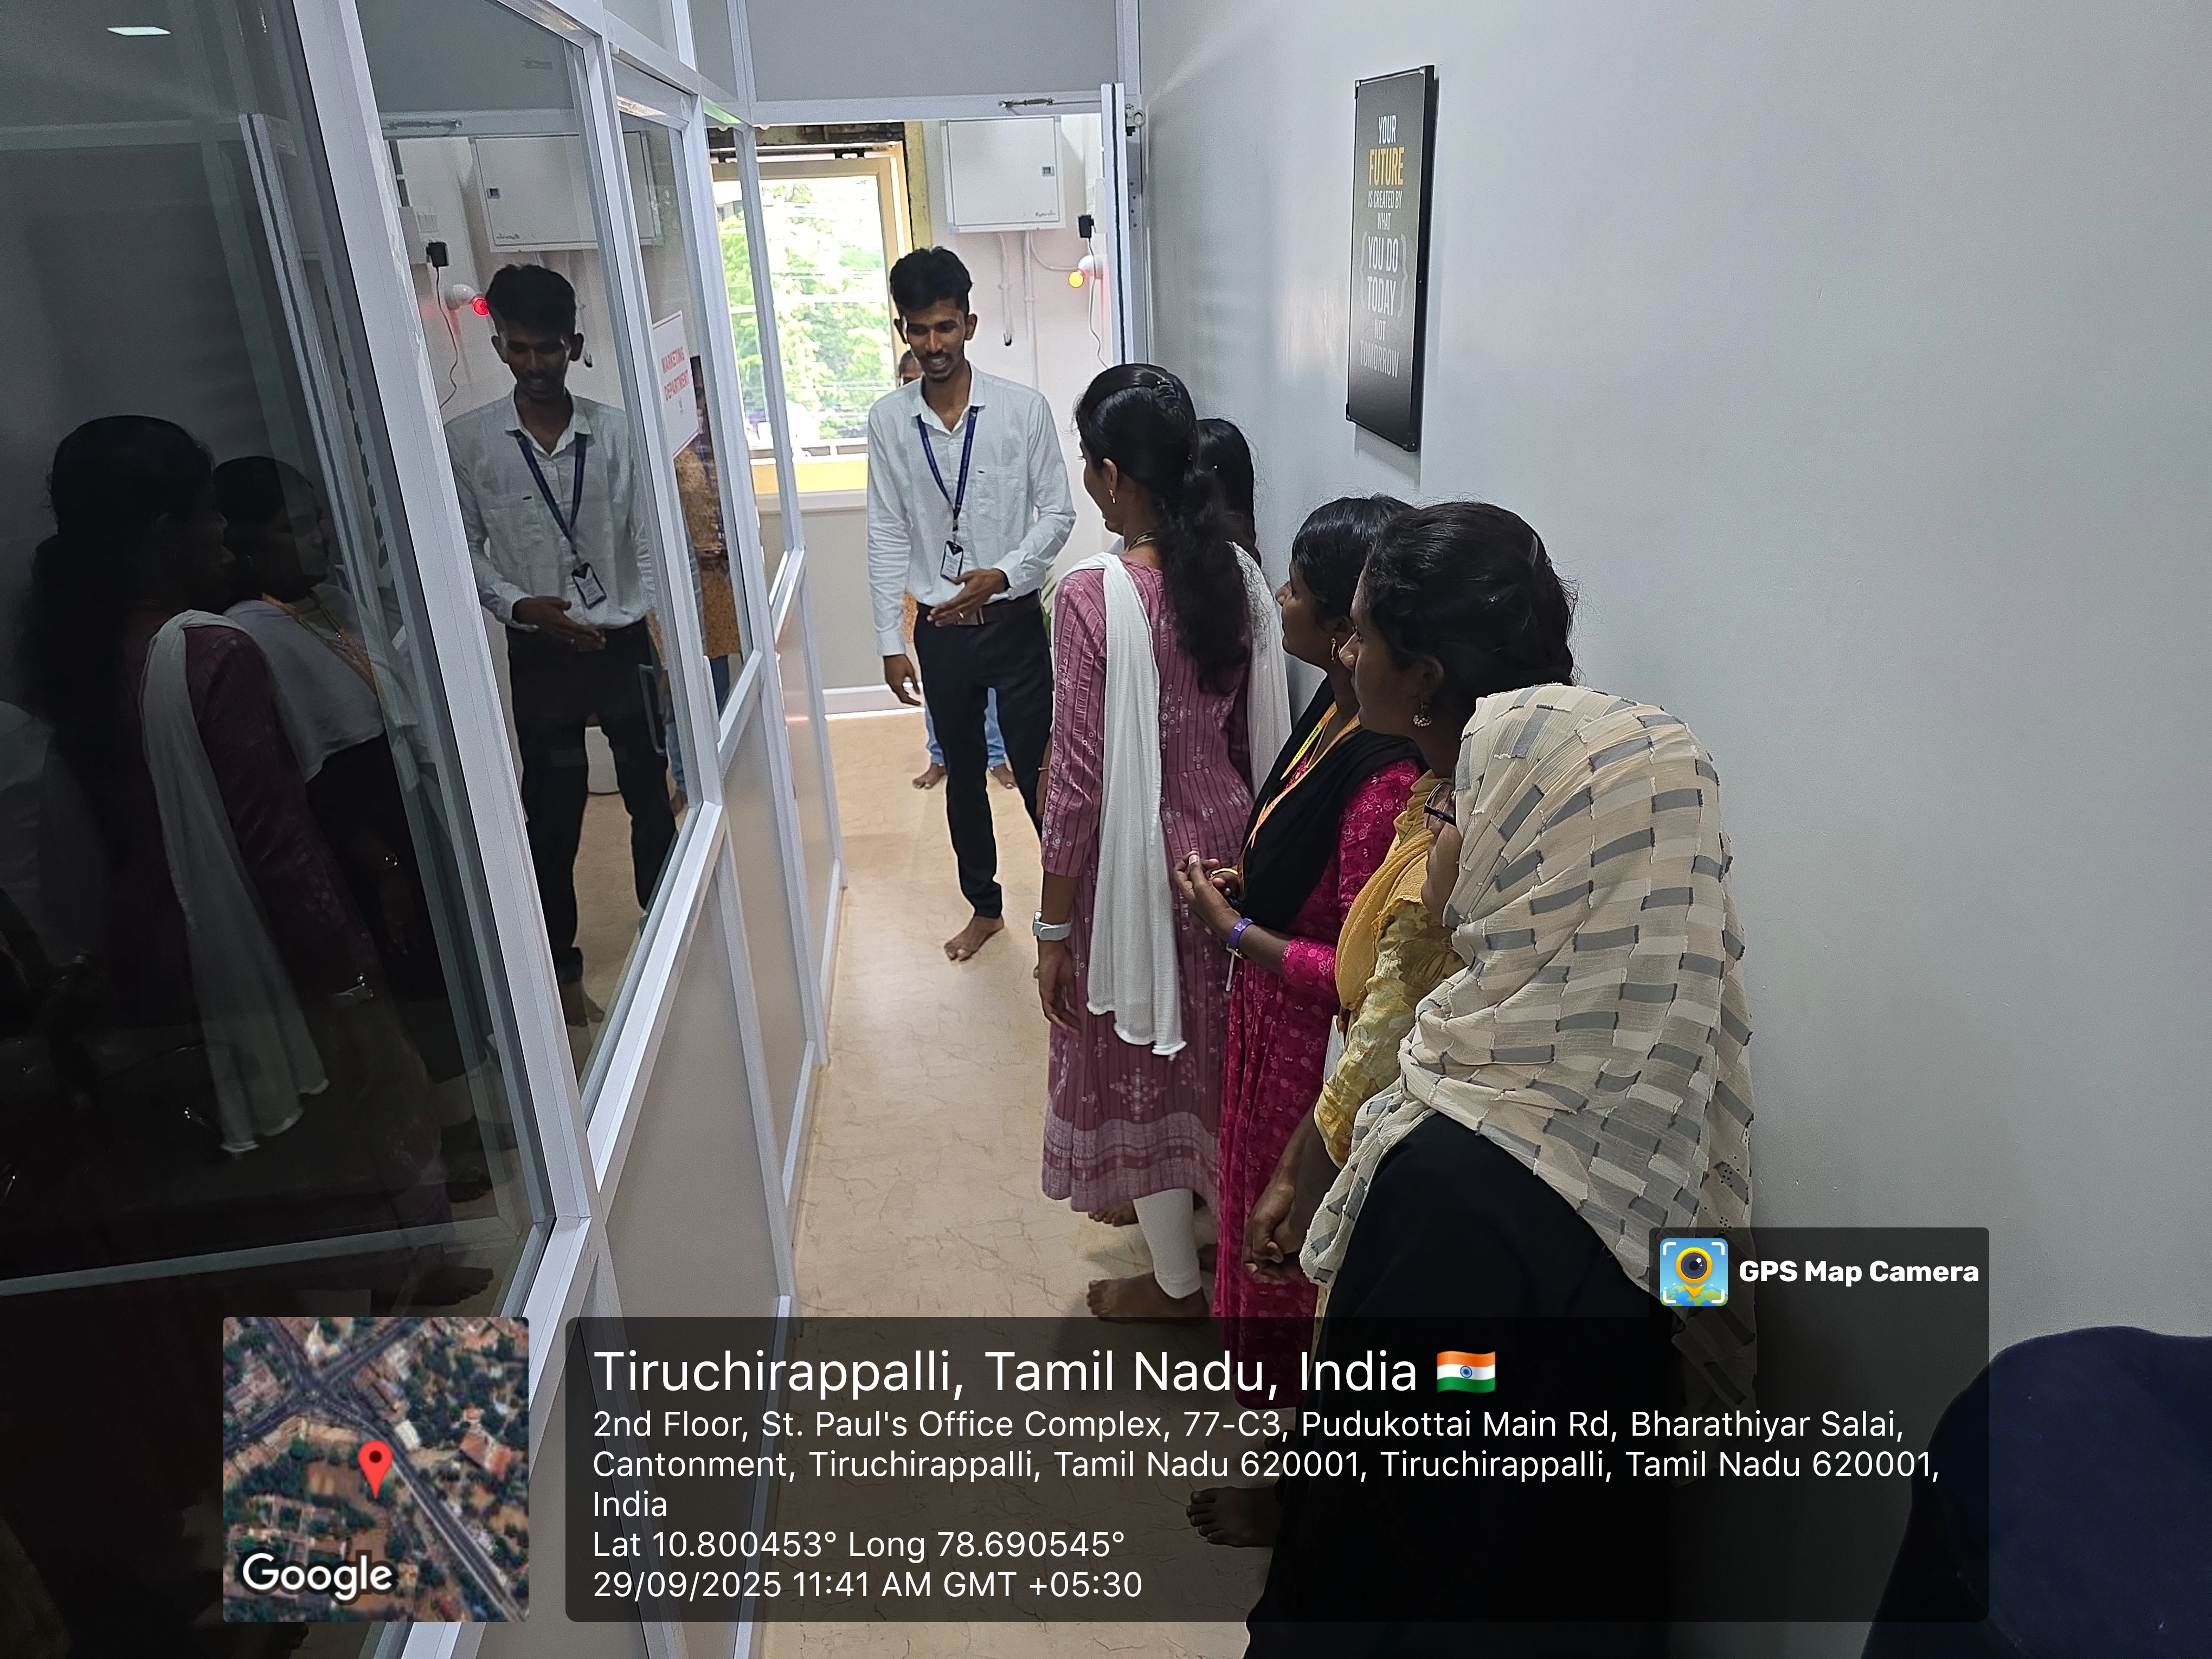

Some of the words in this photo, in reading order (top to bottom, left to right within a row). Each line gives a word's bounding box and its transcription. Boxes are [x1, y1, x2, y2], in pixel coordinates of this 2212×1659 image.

[1378, 114, 1397, 144] YOUR
[1368, 147, 1405, 186] FUTURE
[1368, 190, 1373, 208] IS
[1373, 190, 1394, 209] CREATED
[1395, 190, 1403, 209] BY
[1377, 212, 1391, 230] WHAT
[1368, 236, 1384, 271] YOU
[1386, 238, 1399, 273] DO
[1367, 276, 1397, 316] TODAY
[1374, 319, 1386, 342] NOT
[1360, 340, 1399, 378] TOMORROW
[664, 369, 690, 402] DEPARTMENT
